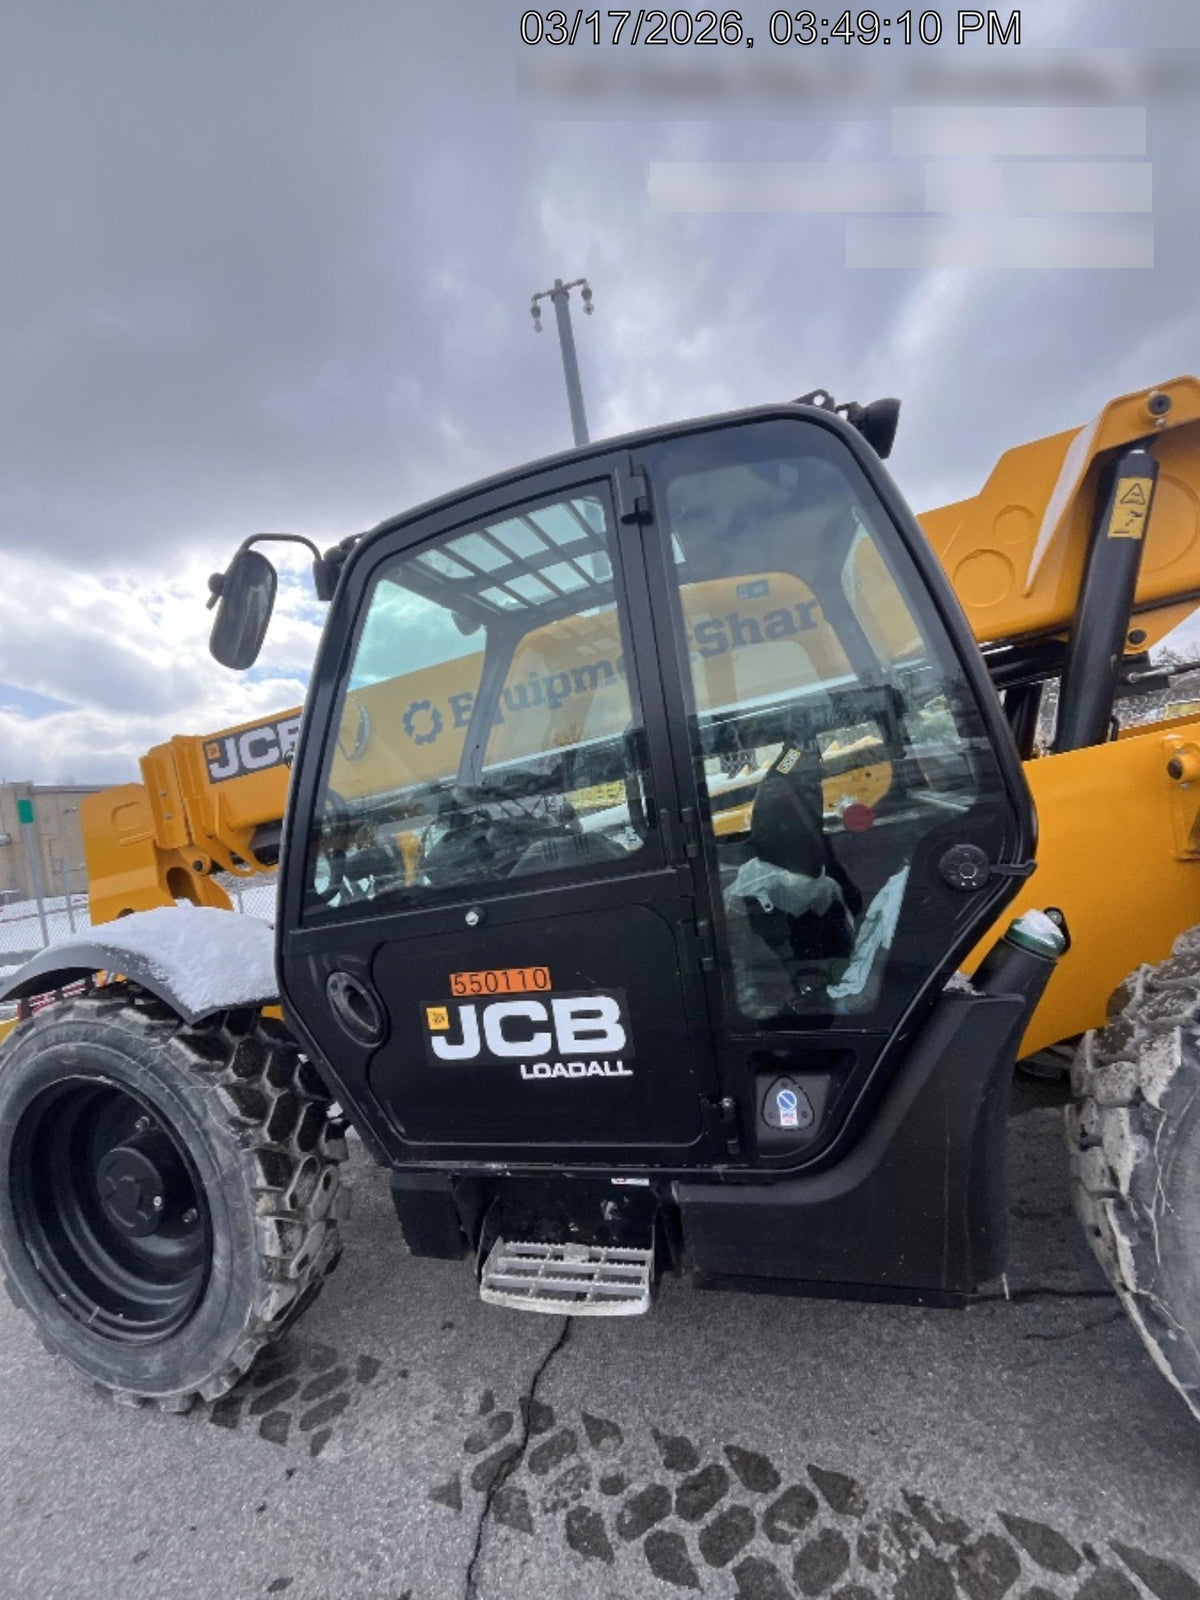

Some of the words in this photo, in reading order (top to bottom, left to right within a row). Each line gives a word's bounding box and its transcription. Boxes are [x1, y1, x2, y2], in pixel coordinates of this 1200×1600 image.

[454, 968, 548, 994] 550110
[431, 996, 627, 1060] JCB
[520, 1061, 634, 1080] LOADALL
